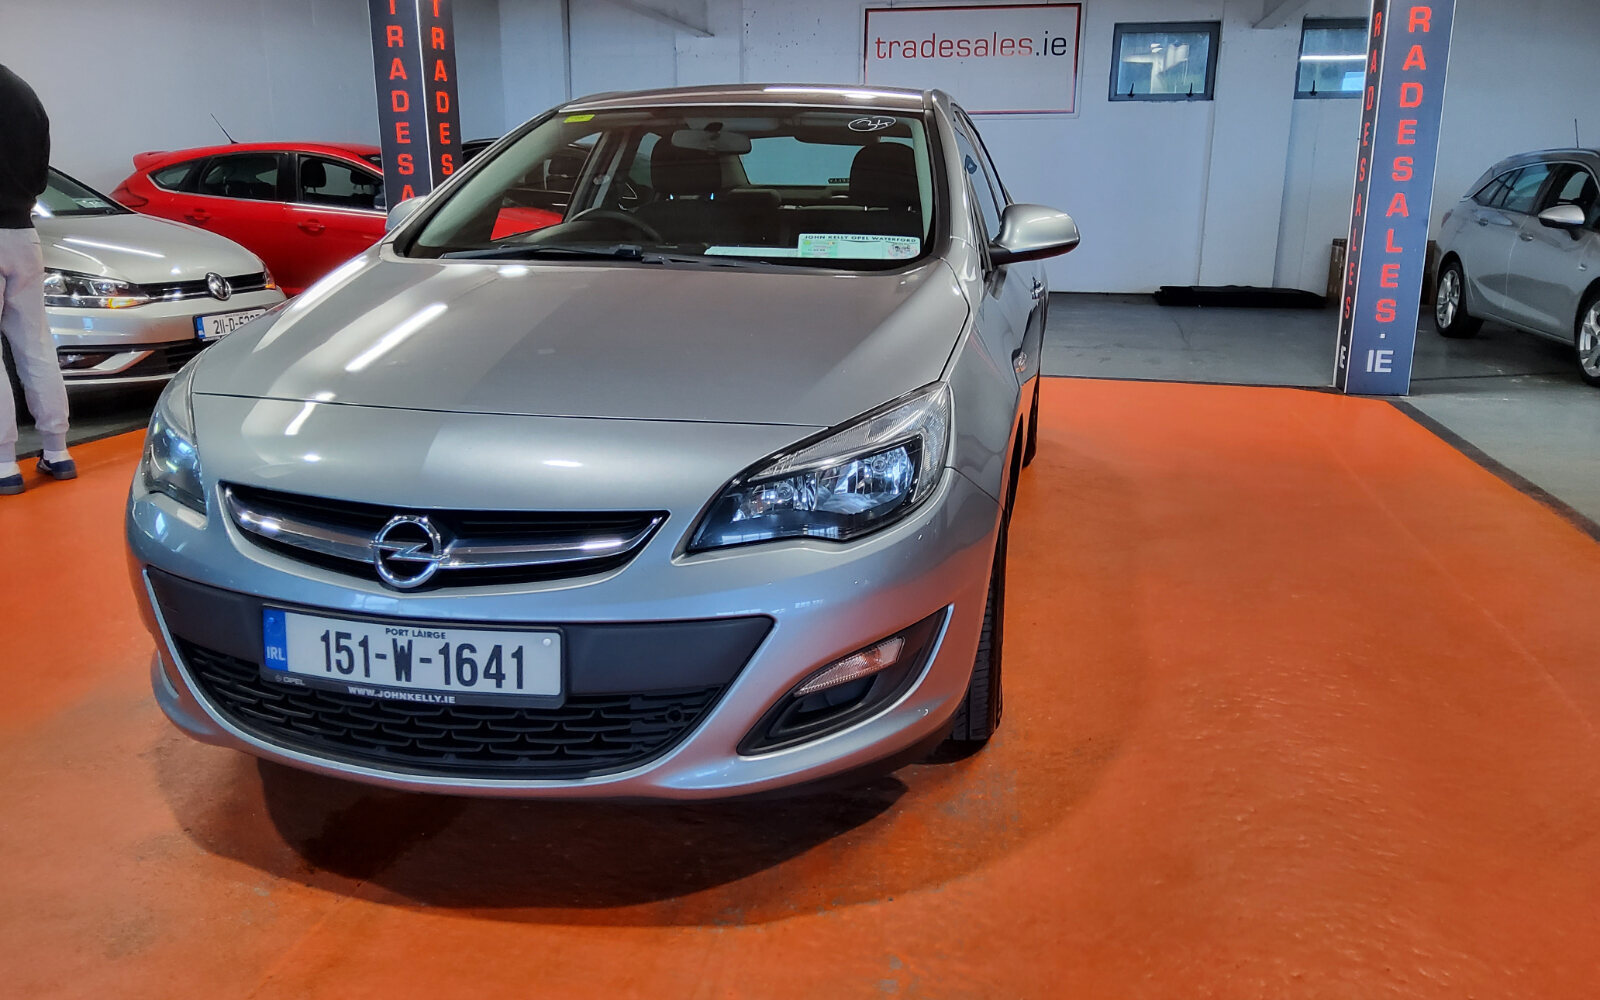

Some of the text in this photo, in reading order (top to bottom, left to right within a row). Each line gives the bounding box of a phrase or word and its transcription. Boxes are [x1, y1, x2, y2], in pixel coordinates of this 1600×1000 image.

[875, 31, 1067, 59] tradesales.ie
[385, 627, 409, 637] PORT
[266, 646, 287, 661] IRL
[320, 629, 524, 690] 151-W-1641
[283, 676, 306, 686] OPEL
[347, 685, 457, 704] WWW.JOHNKELLY.IE
